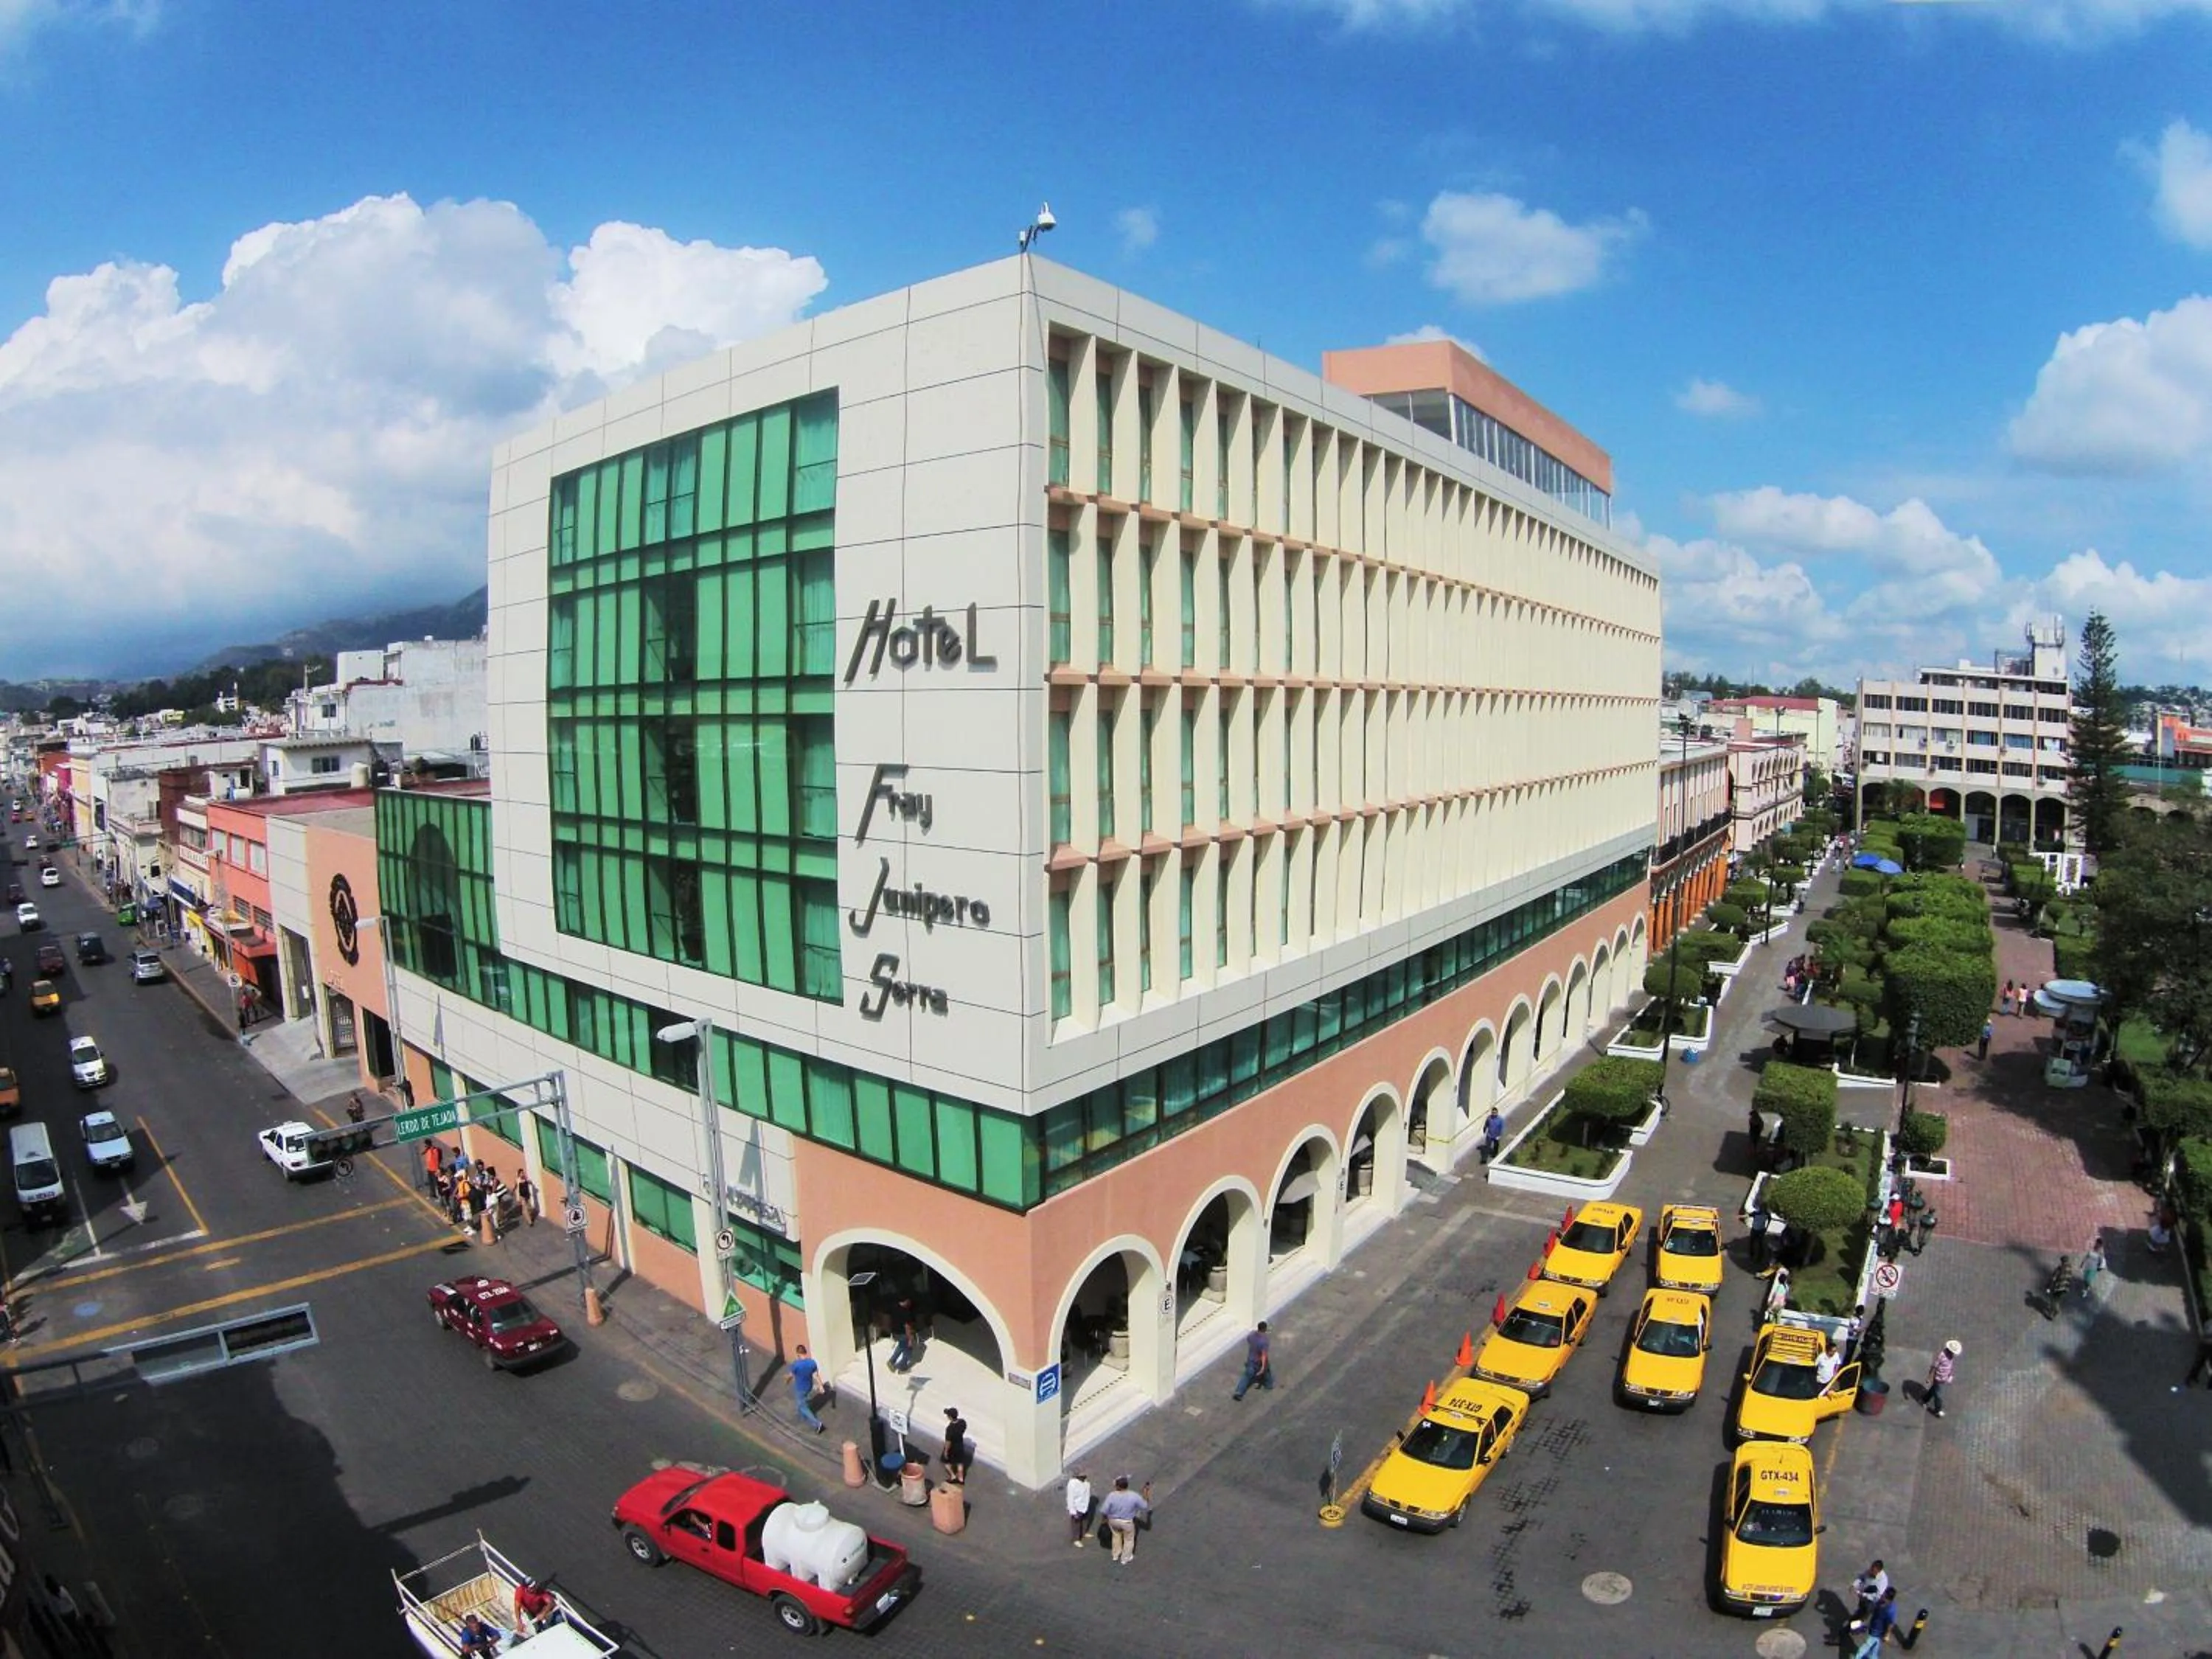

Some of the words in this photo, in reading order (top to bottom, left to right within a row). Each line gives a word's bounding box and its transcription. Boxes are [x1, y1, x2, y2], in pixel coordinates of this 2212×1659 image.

[855, 764, 933, 848] Fray
[849, 857, 990, 938] Junipero
[860, 953, 948, 1021] Serra
[398, 1119, 420, 1134] LERDO
[421, 1116, 431, 1130] DE
[1761, 1470, 1799, 1482] GTX-434
